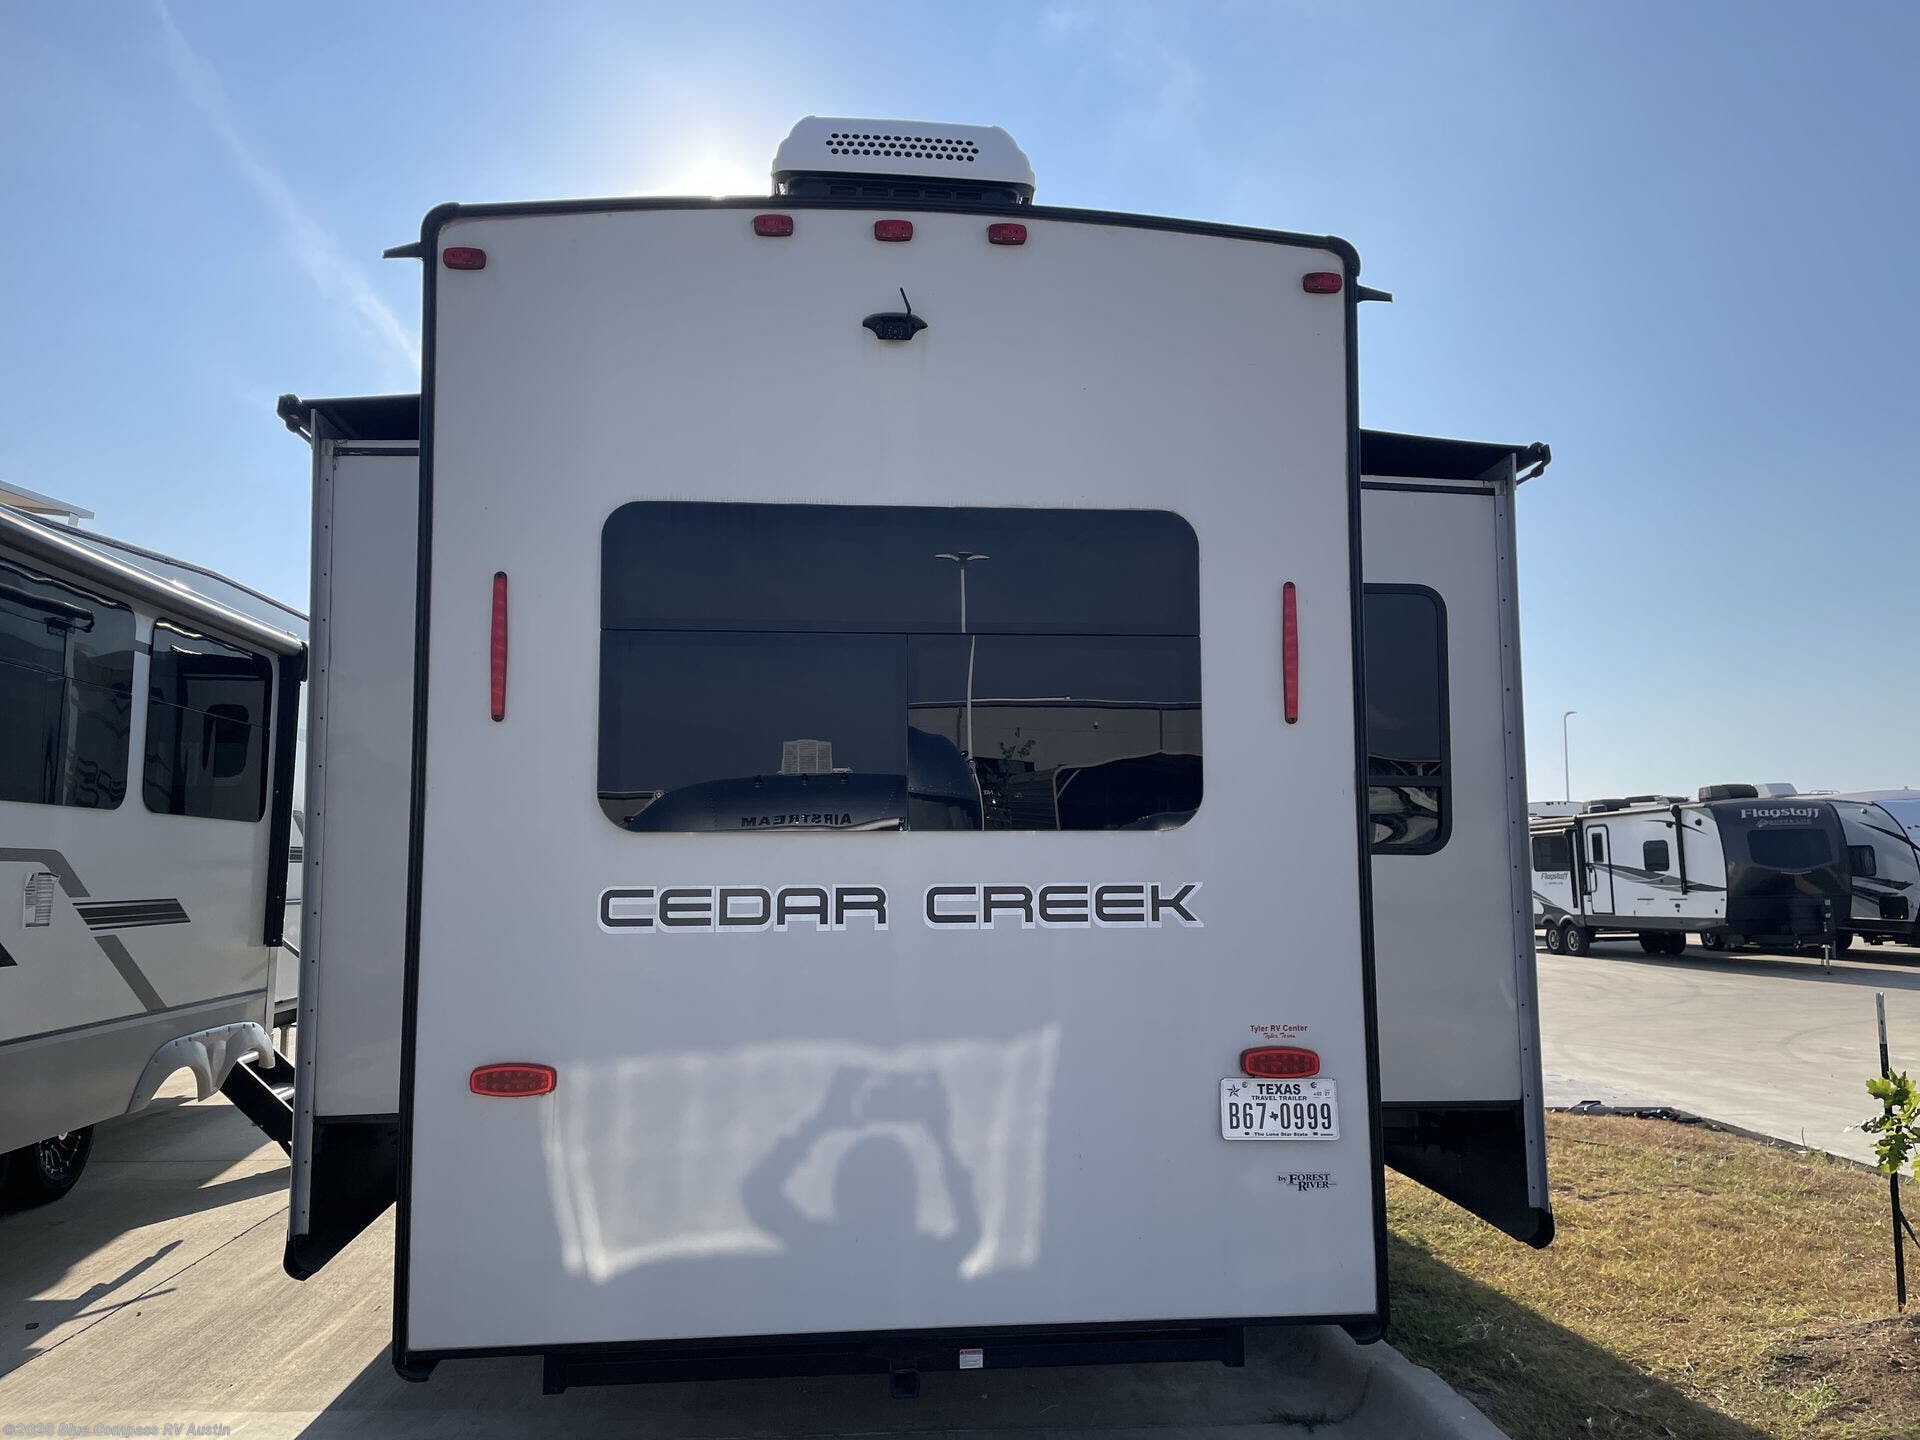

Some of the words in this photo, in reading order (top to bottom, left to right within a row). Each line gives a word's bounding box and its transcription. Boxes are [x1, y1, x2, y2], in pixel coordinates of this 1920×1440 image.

[1740, 807, 1820, 818] Flagstaff
[598, 885, 889, 933] CEDAR
[923, 881, 1204, 929] CREEK
[1250, 1024, 1269, 1033] Tyler
[1270, 1024, 1281, 1032] RV
[1282, 1024, 1308, 1032] Center
[1257, 1083, 1301, 1095] TEXAS
[1228, 1102, 1266, 1130] B67
[1279, 1102, 1332, 1130] 0999
[1278, 1175, 1287, 1183] by
[1288, 1173, 1330, 1184] FOREST
[1298, 1181, 1329, 1191] RIVER
